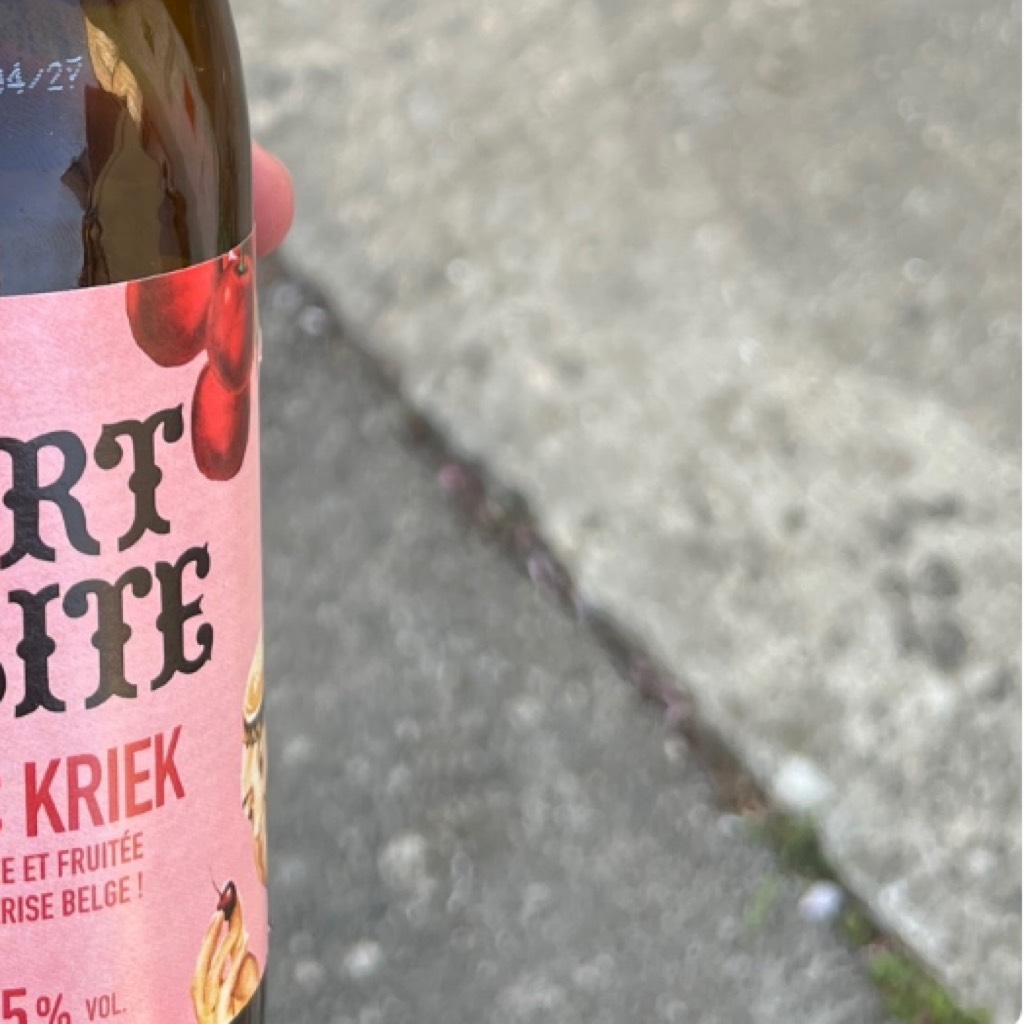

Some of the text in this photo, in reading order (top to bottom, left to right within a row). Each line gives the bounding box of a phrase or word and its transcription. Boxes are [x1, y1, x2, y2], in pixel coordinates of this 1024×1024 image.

[25, 725, 186, 838] KRIEK
[23, 852, 49, 882] ET
[57, 828, 144, 878] FRUITÉE
[62, 875, 130, 917] BELGE
[137, 871, 144, 900] !
[85, 992, 128, 1021] VOL.
